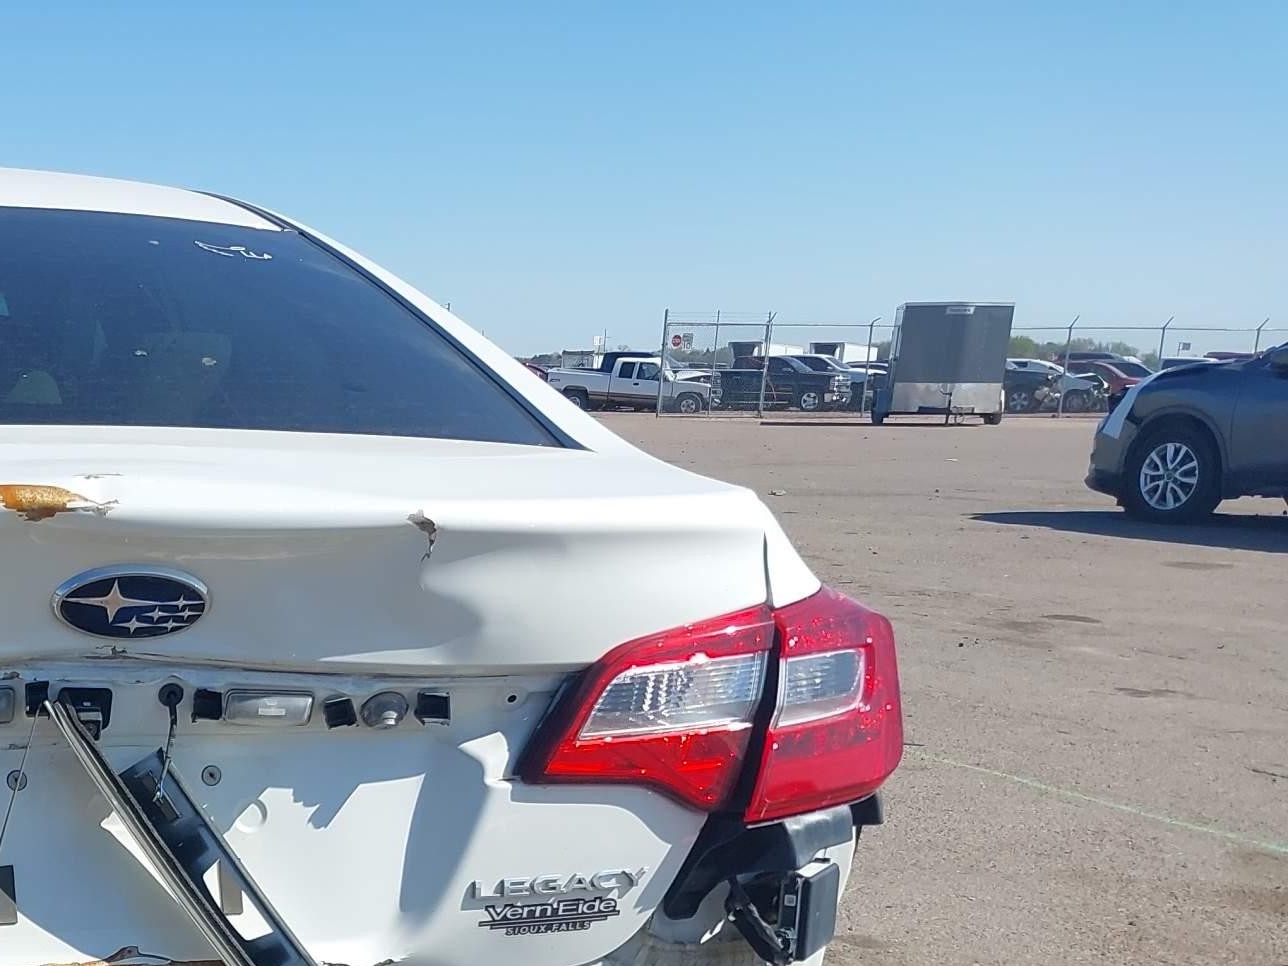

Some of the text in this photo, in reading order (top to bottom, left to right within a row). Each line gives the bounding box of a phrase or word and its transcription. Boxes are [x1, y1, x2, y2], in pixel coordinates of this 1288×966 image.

[473, 867, 650, 898] LEGACY
[486, 898, 618, 921] Vern Eide
[505, 921, 591, 936] SIOUX FALLS
